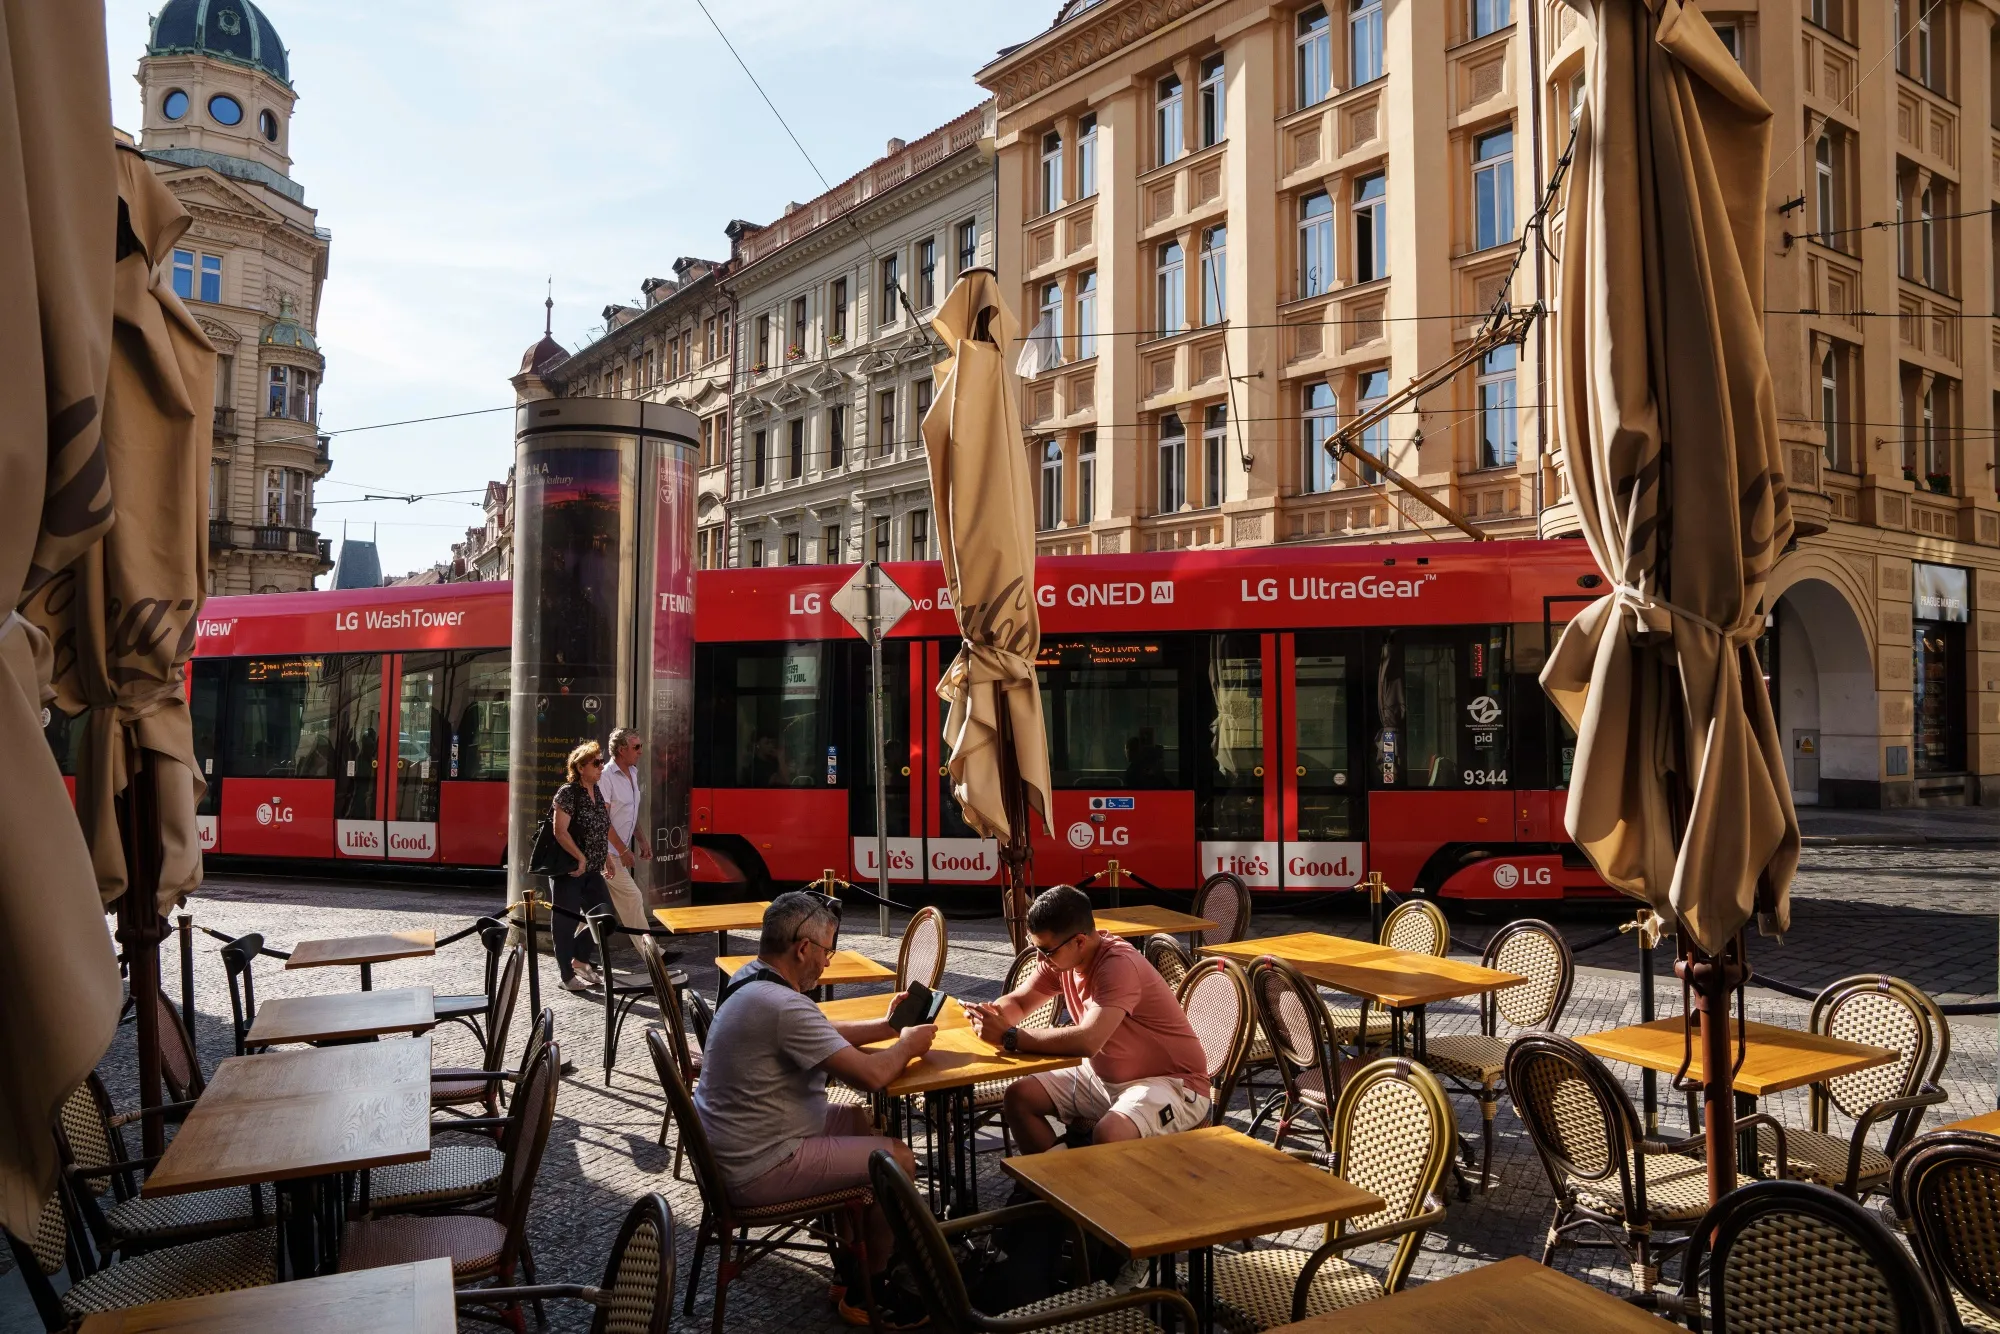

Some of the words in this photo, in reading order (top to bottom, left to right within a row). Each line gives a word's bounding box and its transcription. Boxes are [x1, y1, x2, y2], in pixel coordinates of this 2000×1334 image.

[1036, 584, 1056, 607] G
[1067, 583, 1145, 607] QNED
[1154, 585, 1171, 600] AI
[1242, 578, 1278, 602] LG
[789, 593, 821, 615] LG
[910, 598, 933, 611] vo
[1920, 595, 1940, 607] PRAGUE
[1940, 597, 1959, 609] MARKET
[336, 612, 358, 631] LG
[366, 608, 465, 630] WashTower
[1474, 733, 1493, 745] pid
[1463, 769, 1508, 786] 9344
[275, 808, 293, 823] LG
[346, 830, 379, 849] Life's
[390, 832, 431, 851] Good.
[1099, 826, 1129, 846] LG
[867, 849, 914, 870] Lfe's
[931, 851, 991, 871] Good.
[1216, 855, 1269, 876] Life's
[1288, 856, 1355, 877] Good.
[1523, 868, 1551, 885] LG
